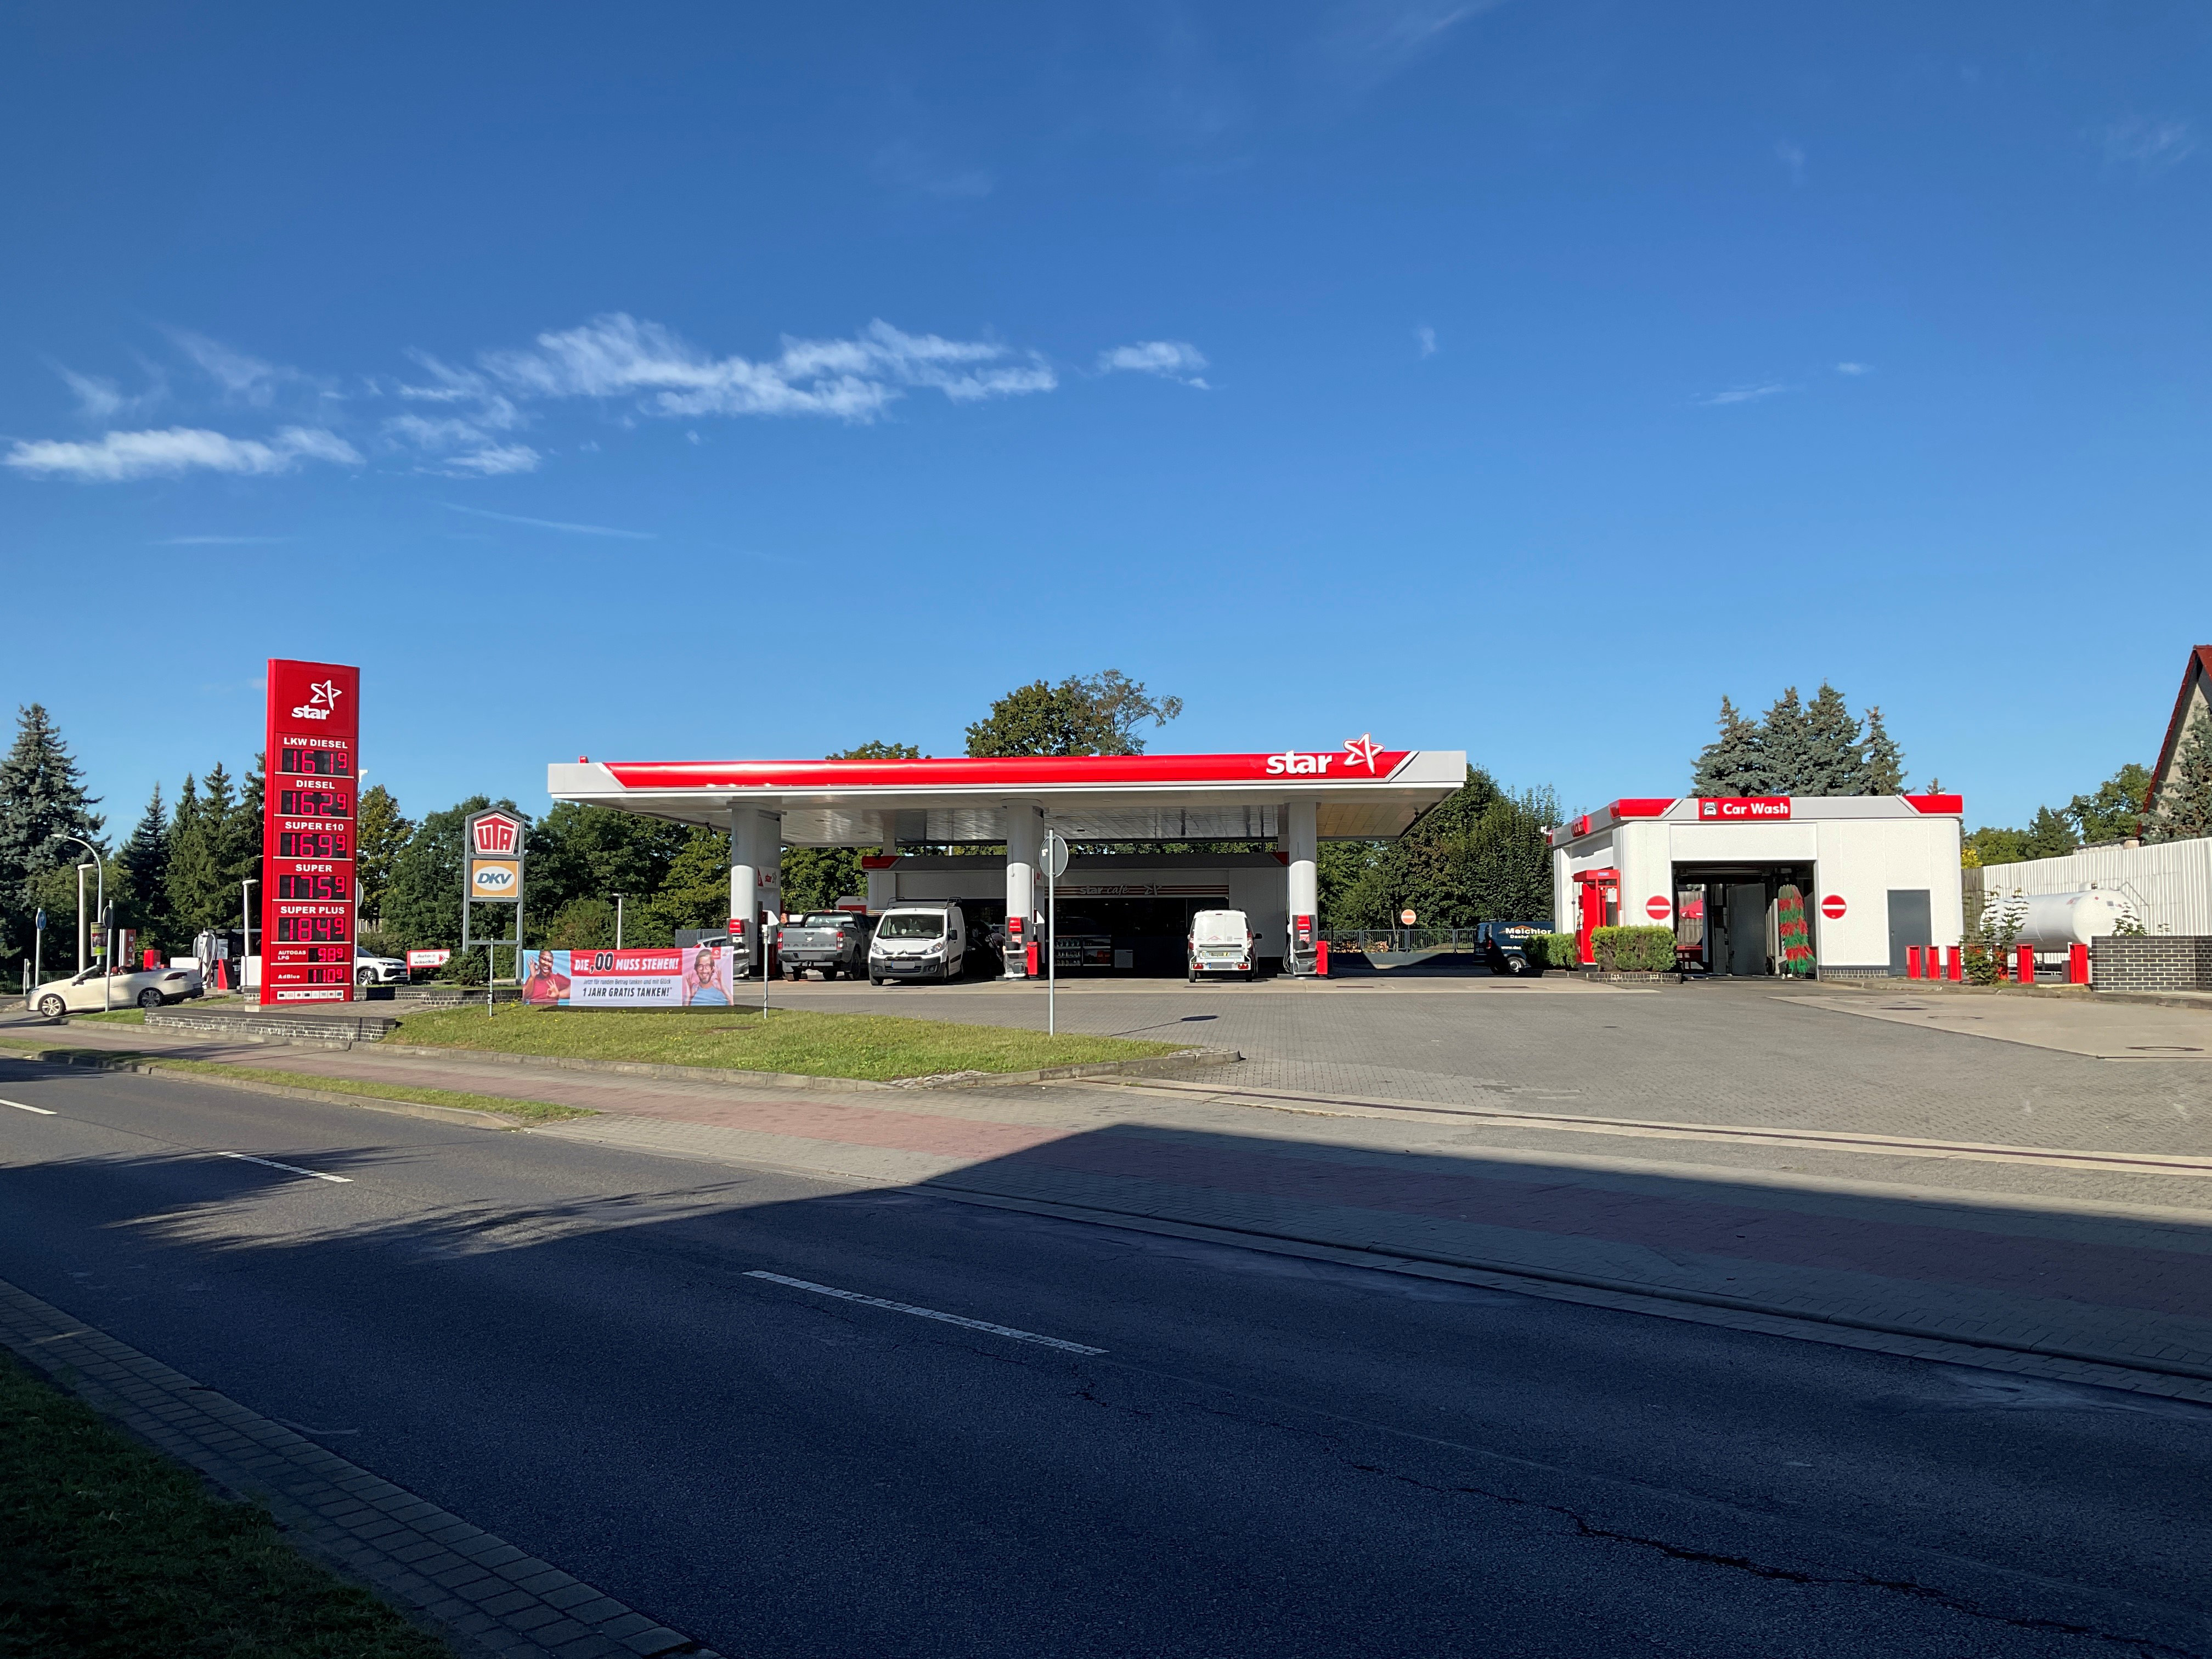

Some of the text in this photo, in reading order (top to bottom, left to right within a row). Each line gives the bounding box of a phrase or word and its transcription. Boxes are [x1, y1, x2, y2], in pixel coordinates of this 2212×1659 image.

[291, 705, 330, 720] star
[284, 737, 348, 749] LKW DIESEL
[1266, 750, 1332, 774] star
[296, 780, 335, 789] DIESEL
[1723, 803, 1788, 815] Car Wash
[285, 821, 344, 831] SUPER E10
[476, 817, 515, 850] UTA
[295, 864, 332, 872] SUPER
[477, 873, 512, 884] DKV
[1080, 884, 1129, 895] star café
[574, 959, 589, 970] DIE
[616, 958, 640, 970] MUSS
[641, 958, 679, 970] STEHEN!
[583, 988, 587, 997] 1
[588, 988, 607, 997] JAHR
[608, 988, 635, 997] GRATIS
